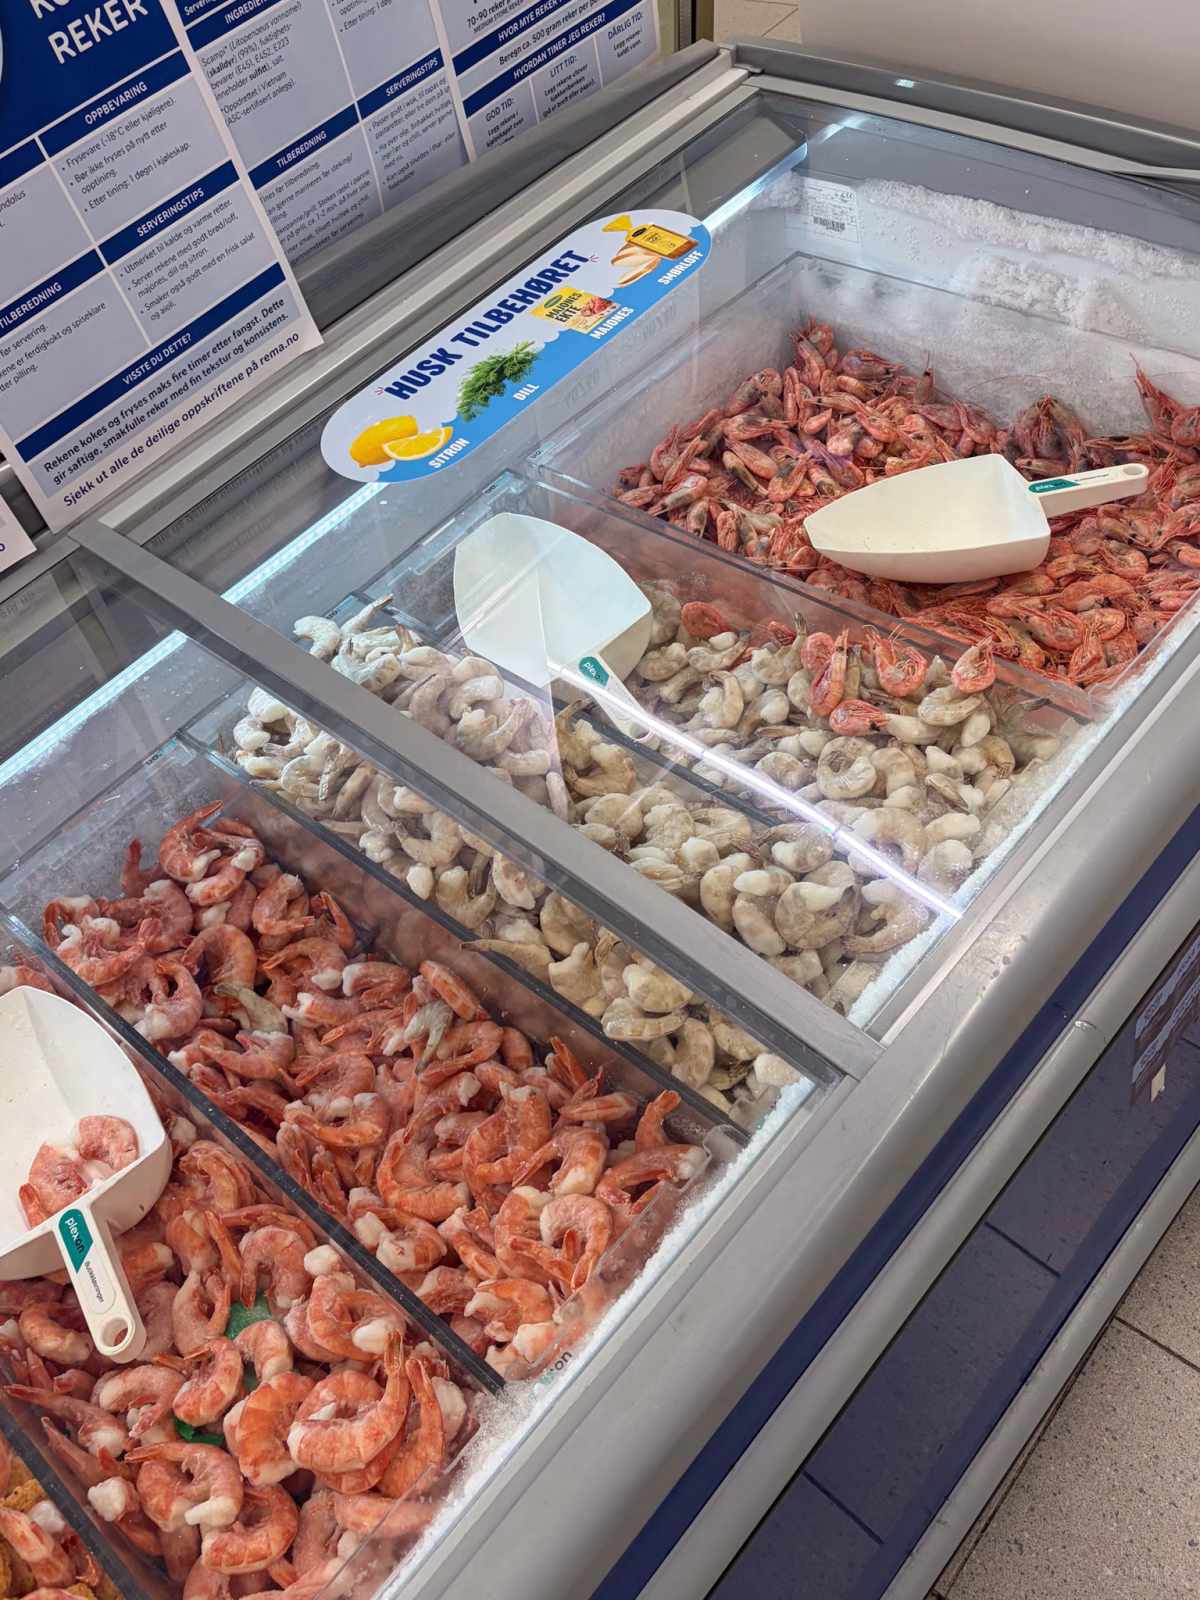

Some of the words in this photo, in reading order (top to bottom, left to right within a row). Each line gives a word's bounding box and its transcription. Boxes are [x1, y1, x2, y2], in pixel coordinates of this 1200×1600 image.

[48, 0, 148, 64] REKER
[467, 9, 488, 28] 70-90
[498, 22, 519, 42] HVOR
[519, 11, 535, 28] MYE
[535, 0, 557, 17] REKER
[499, 46, 522, 65] Beregn
[522, 41, 532, 50] ca.
[532, 29, 545, 43] 500
[545, 20, 562, 36] gram
[562, 9, 577, 24] reker
[578, 2, 589, 14] per
[608, 19, 631, 40] DÅRLIG
[631, 12, 643, 23] TID:
[207, 55, 237, 79] (skalldyr)
[259, 24, 292, 46] fuktighets-
[210, 71, 234, 90] bevarer
[273, 36, 289, 52] E223
[514, 51, 547, 79] HVORDAN
[547, 38, 567, 56] TINER
[568, 29, 580, 43] JEG
[580, 13, 605, 34] REKER?
[550, 62, 563, 78] LITT
[564, 55, 577, 67] TID:
[214, 77, 248, 101] inneholder
[272, 55, 285, 67] salt.
[257, 85, 261, 93] i
[260, 72, 287, 90] Vietnam
[385, 55, 439, 98] SERVERINGSTIPS
[85, 81, 147, 124] OPPBEVARING
[486, 106, 500, 122] GOD
[501, 98, 514, 111] TID:
[66, 143, 101, 168] Frysevare
[125, 118, 141, 132] eller
[140, 97, 176, 121] kjøligere).
[74, 171, 88, 183] Bør
[87, 161, 104, 174] ikke
[103, 148, 125, 164] fryses
[125, 140, 136, 153] på
[135, 132, 151, 145] nytt
[150, 122, 167, 136] etter
[276, 131, 327, 167] TILBEREDNING
[81, 169, 118, 194] opptining.
[88, 194, 106, 209] Etter
[106, 180, 130, 197] tining:
[135, 165, 153, 180] døgn
[156, 143, 191, 166] kjøleskap.
[275, 185, 284, 194] før
[284, 162, 320, 188] tilberedning.
[137, 188, 204, 236] SERVERINGSTIPS
[123, 249, 157, 274] Utmerket
[156, 243, 164, 253] til
[163, 232, 183, 247] kalde
[183, 225, 193, 235] og
[192, 212, 213, 228] varme
[213, 200, 232, 215] retter.
[131, 270, 154, 288] Server
[154, 255, 177, 273] rekene
[177, 243, 192, 258] med
[192, 233, 208, 248] godt
[207, 212, 238, 236] brød/loff,
[138, 276, 168, 298] majones,
[168, 266, 179, 278] dill
[179, 261, 189, 270] og
[188, 248, 209, 264] sitron.
[144, 291, 169, 311] Smaker
[170, 279, 186, 294] også
[186, 269, 202, 285] godt
[201, 258, 217, 272] med
[216, 253, 225, 262] en
[225, 243, 240, 256] frisk
[239, 232, 255, 246] salat
[657, 250, 704, 285] SMØRLOFF
[0, 282, 62, 328] TILBEREDNING
[151, 311, 161, 321] og
[160, 300, 176, 315] aioli.
[384, 347, 464, 400] HUSK
[450, 250, 590, 347] TILBEHØRET
[545, 292, 583, 319] MAJONES
[554, 305, 581, 323] EKTE
[589, 306, 635, 340] MAJONES
[0, 347, 11, 357] før
[12, 324, 48, 350] servering.
[16, 357, 24, 366] er
[24, 332, 62, 360] ferdigkokt
[61, 326, 72, 335] og
[71, 303, 106, 329] spiseklare
[13, 364, 38, 384] pilling.
[122, 361, 151, 384] VISSTE
[150, 353, 163, 366] DU
[162, 333, 191, 357] DETTE?
[44, 445, 80, 472] Rekene
[79, 426, 107, 448] kokes
[108, 416, 121, 428] og
[120, 397, 148, 419] fryses
[148, 380, 172, 400] maks
[172, 369, 187, 382] fire
[188, 351, 210, 371] timer
[212, 336, 231, 354] etter
[232, 316, 262, 339] fangst.
[261, 299, 284, 318] Dette
[53, 471, 66, 485] gir
[68, 448, 103, 474] saftige,
[103, 415, 146, 449] smakfulle
[146, 398, 168, 418] reker
[170, 382, 189, 401] med
[189, 375, 202, 386] fin
[202, 352, 231, 377] tekstur
[233, 344, 244, 355] og
[243, 314, 289, 347] konsistens.
[512, 383, 540, 401] DILL
[63, 481, 95, 507] Sjekk
[96, 470, 109, 484] ut
[109, 457, 129, 474] alle
[130, 446, 144, 459] de
[146, 419, 180, 448] deilige
[182, 373, 244, 422] oppskriftene
[245, 360, 259, 377] på
[259, 333, 299, 365] rema.no
[428, 437, 470, 469] SITRON
[1034, 480, 1066, 492] plexon
[582, 661, 604, 685] plexon
[64, 1216, 86, 1254] plexon
